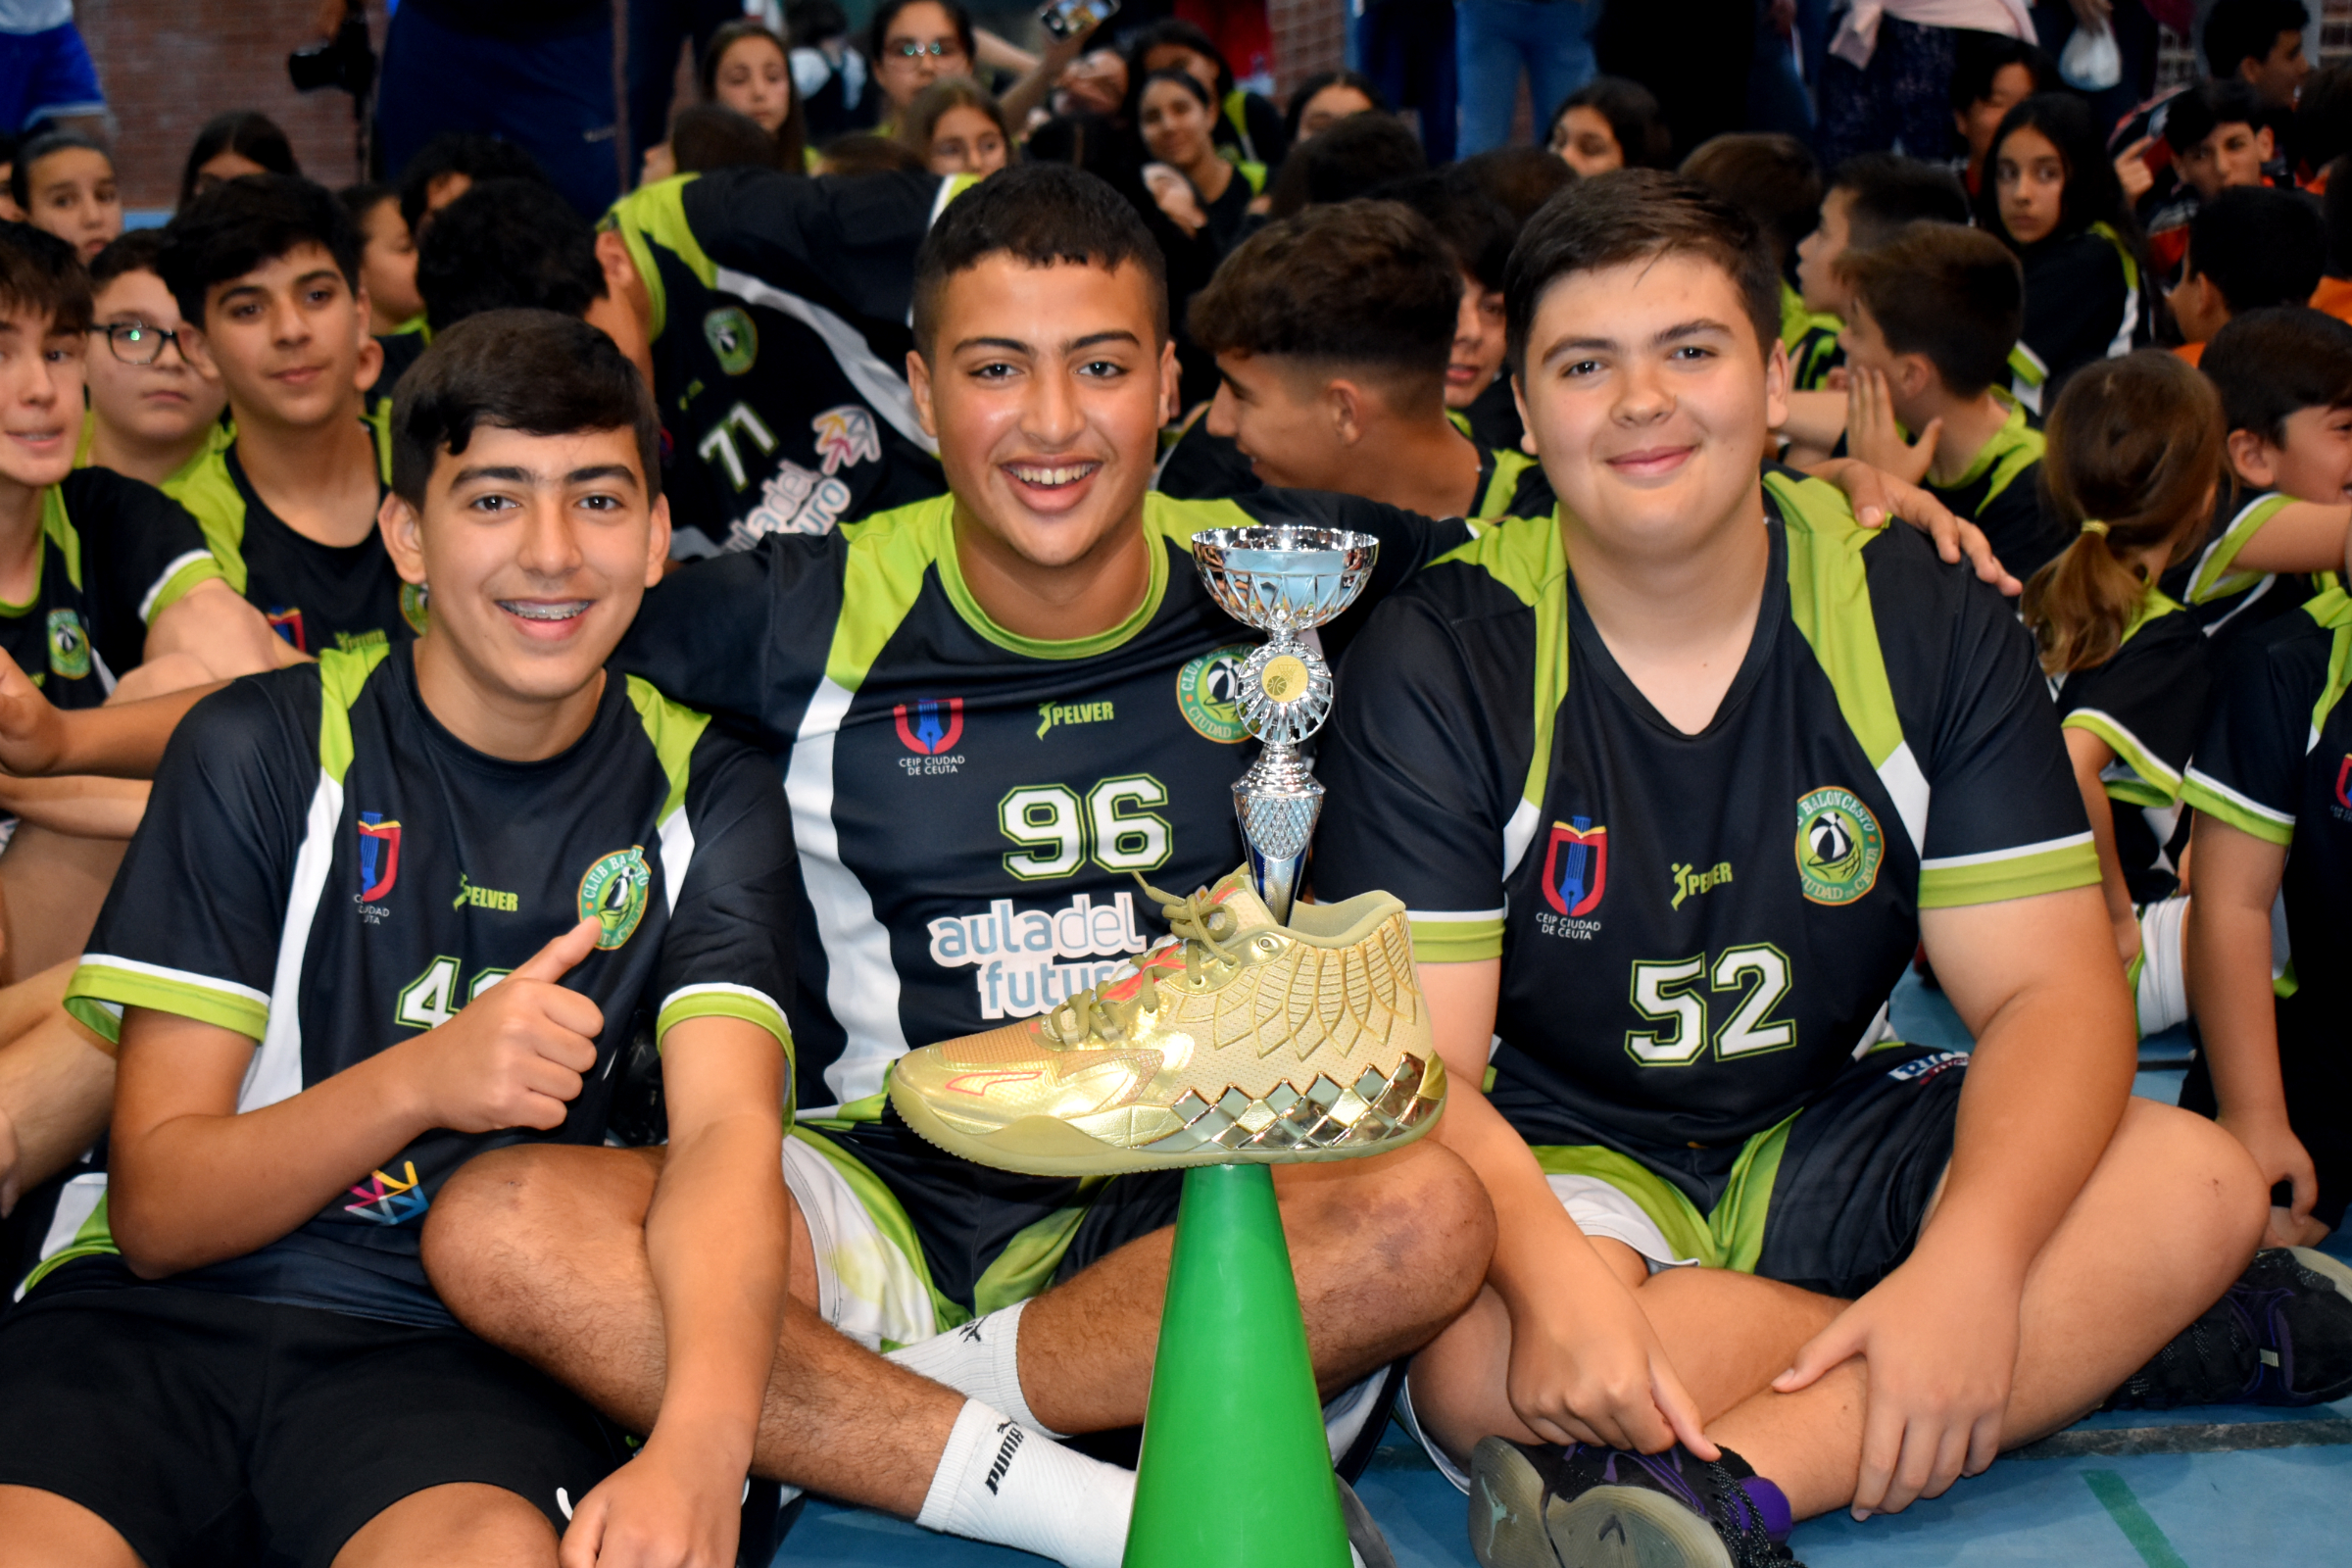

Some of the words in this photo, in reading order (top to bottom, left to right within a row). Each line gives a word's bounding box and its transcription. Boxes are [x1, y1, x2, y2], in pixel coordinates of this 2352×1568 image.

[899, 757, 921, 767] CEIP
[924, 755, 965, 765] CIUDAD
[907, 767, 921, 776] DE
[924, 765, 958, 775] CEUTA
[998, 773, 1173, 881] 96
[582, 864, 609, 899] CLUB
[1536, 911, 1558, 924] CEIP
[1560, 916, 1601, 931] CIUDAD
[1542, 923, 1555, 935] DE
[1557, 927, 1592, 941] CEUTA
[394, 955, 515, 1031] 4
[984, 959, 1127, 1010] futur
[1624, 942, 1797, 1067] 52
[985, 1427, 1025, 1496] PUMA
